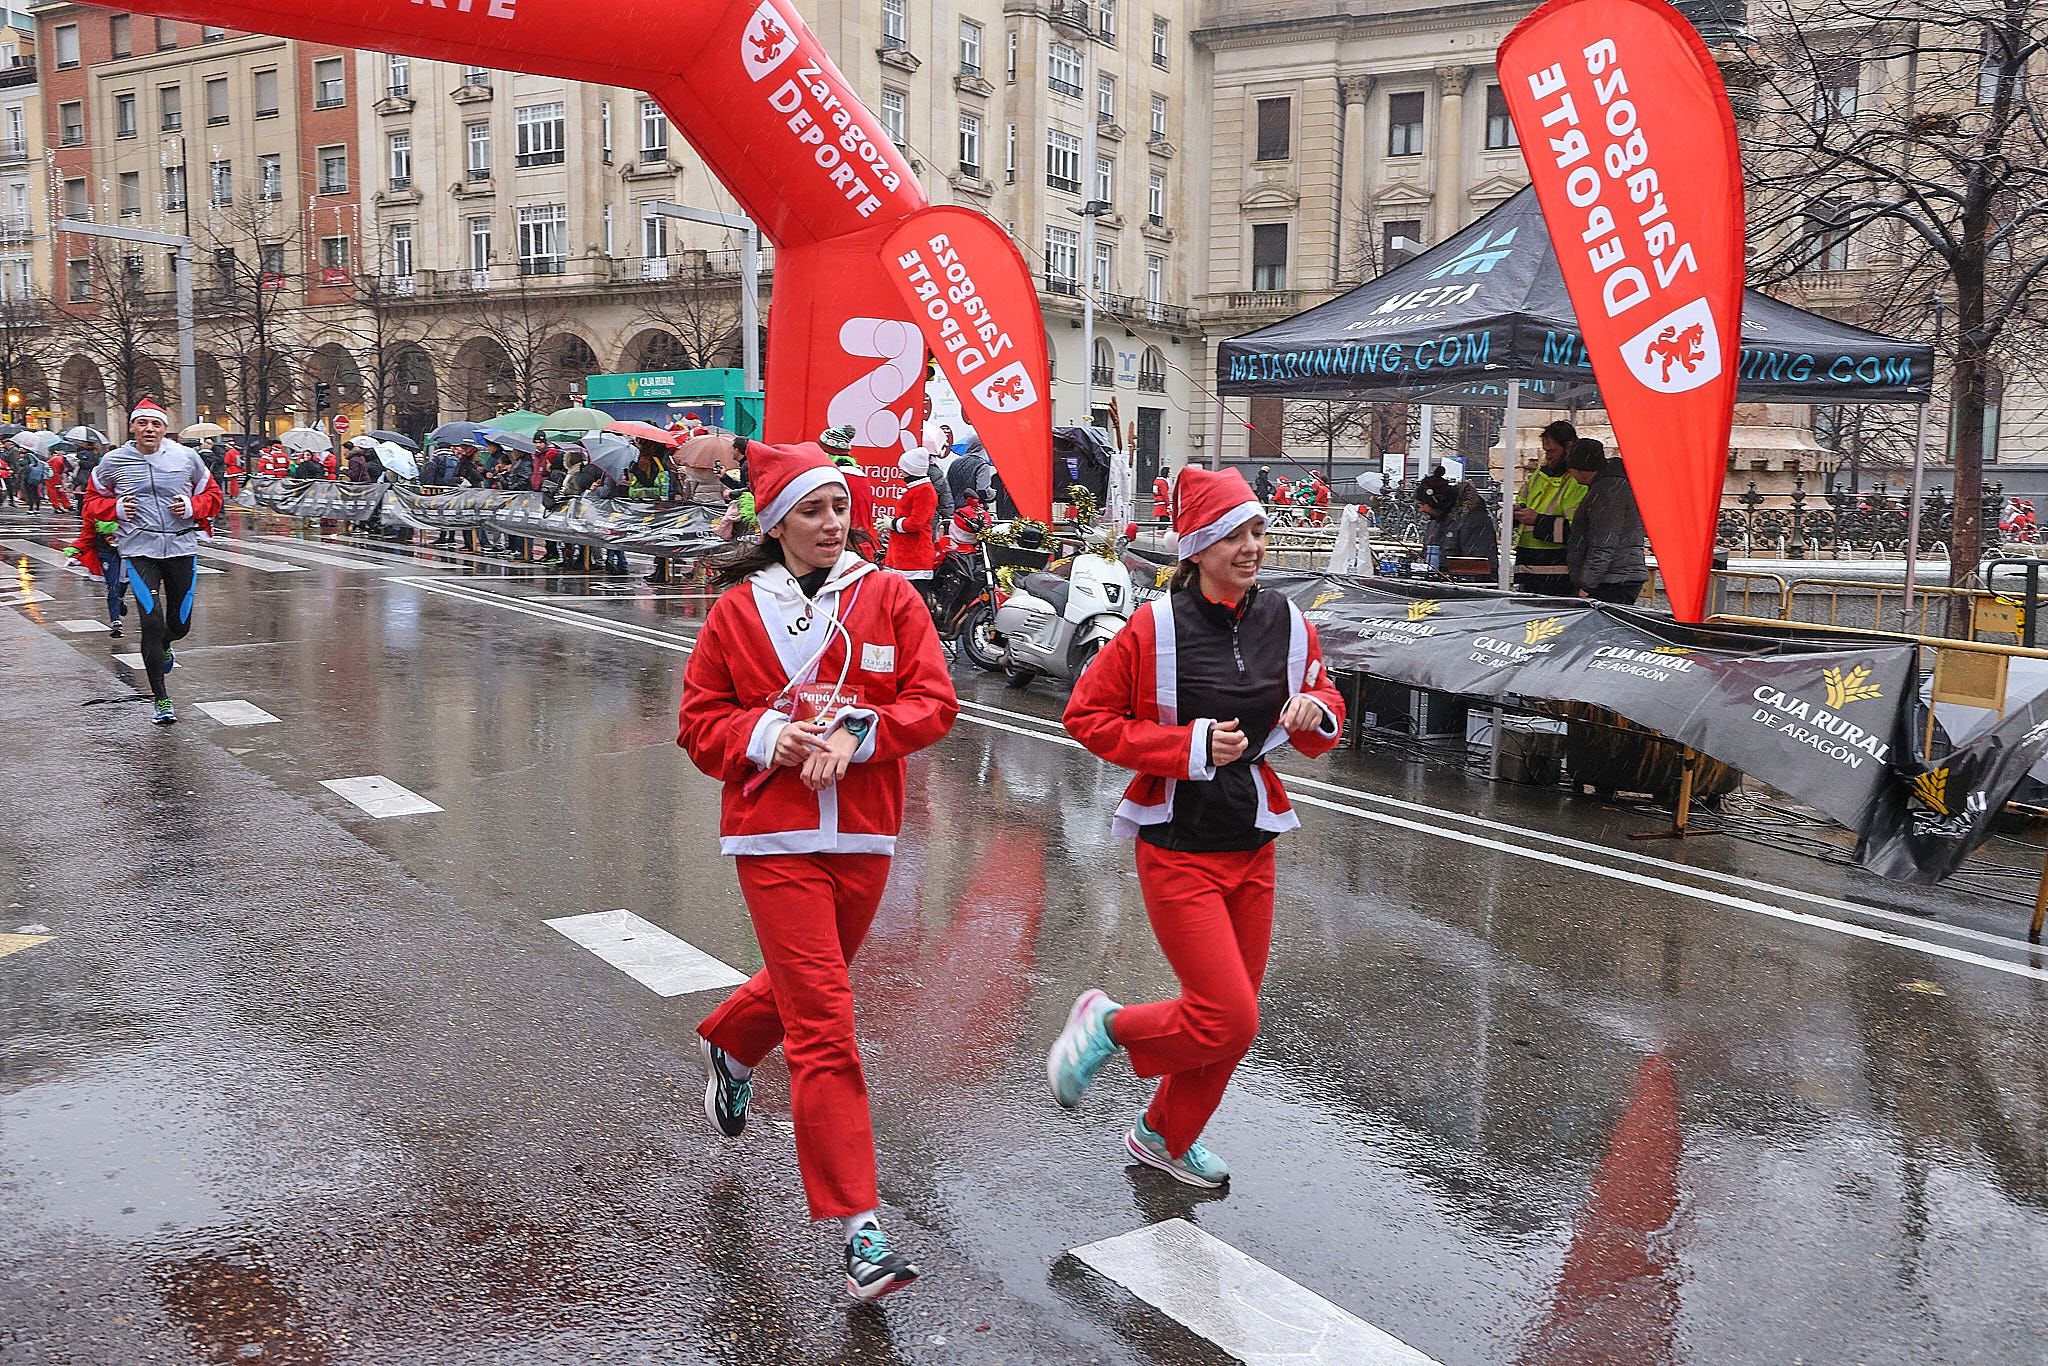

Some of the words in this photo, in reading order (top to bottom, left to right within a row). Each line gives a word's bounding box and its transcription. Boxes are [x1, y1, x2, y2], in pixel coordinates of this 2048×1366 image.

[1466, 31, 1501, 46] DIP
[796, 55, 901, 193] Zaragoza
[767, 78, 883, 218] DEPORTE
[1368, 282, 1483, 316] META
[1341, 311, 1448, 331] RUNNING
[1229, 331, 1491, 382] METARUNNING.COM
[1357, 628, 1372, 639] DE
[1391, 621, 1437, 637] RURAL
[1468, 651, 1491, 665] DE
[1472, 636, 1513, 657] CAJA
[1588, 659, 1608, 669] DE
[1608, 662, 1670, 682] ARAGÓN
[1593, 646, 1637, 663] CAJA
[1632, 649, 1696, 673] RURAL
[1753, 685, 1811, 721] CAJA
[1809, 709, 1890, 765] RURAL
[1752, 708, 1781, 728] DE
[1778, 723, 1864, 769] ARAGÓN
